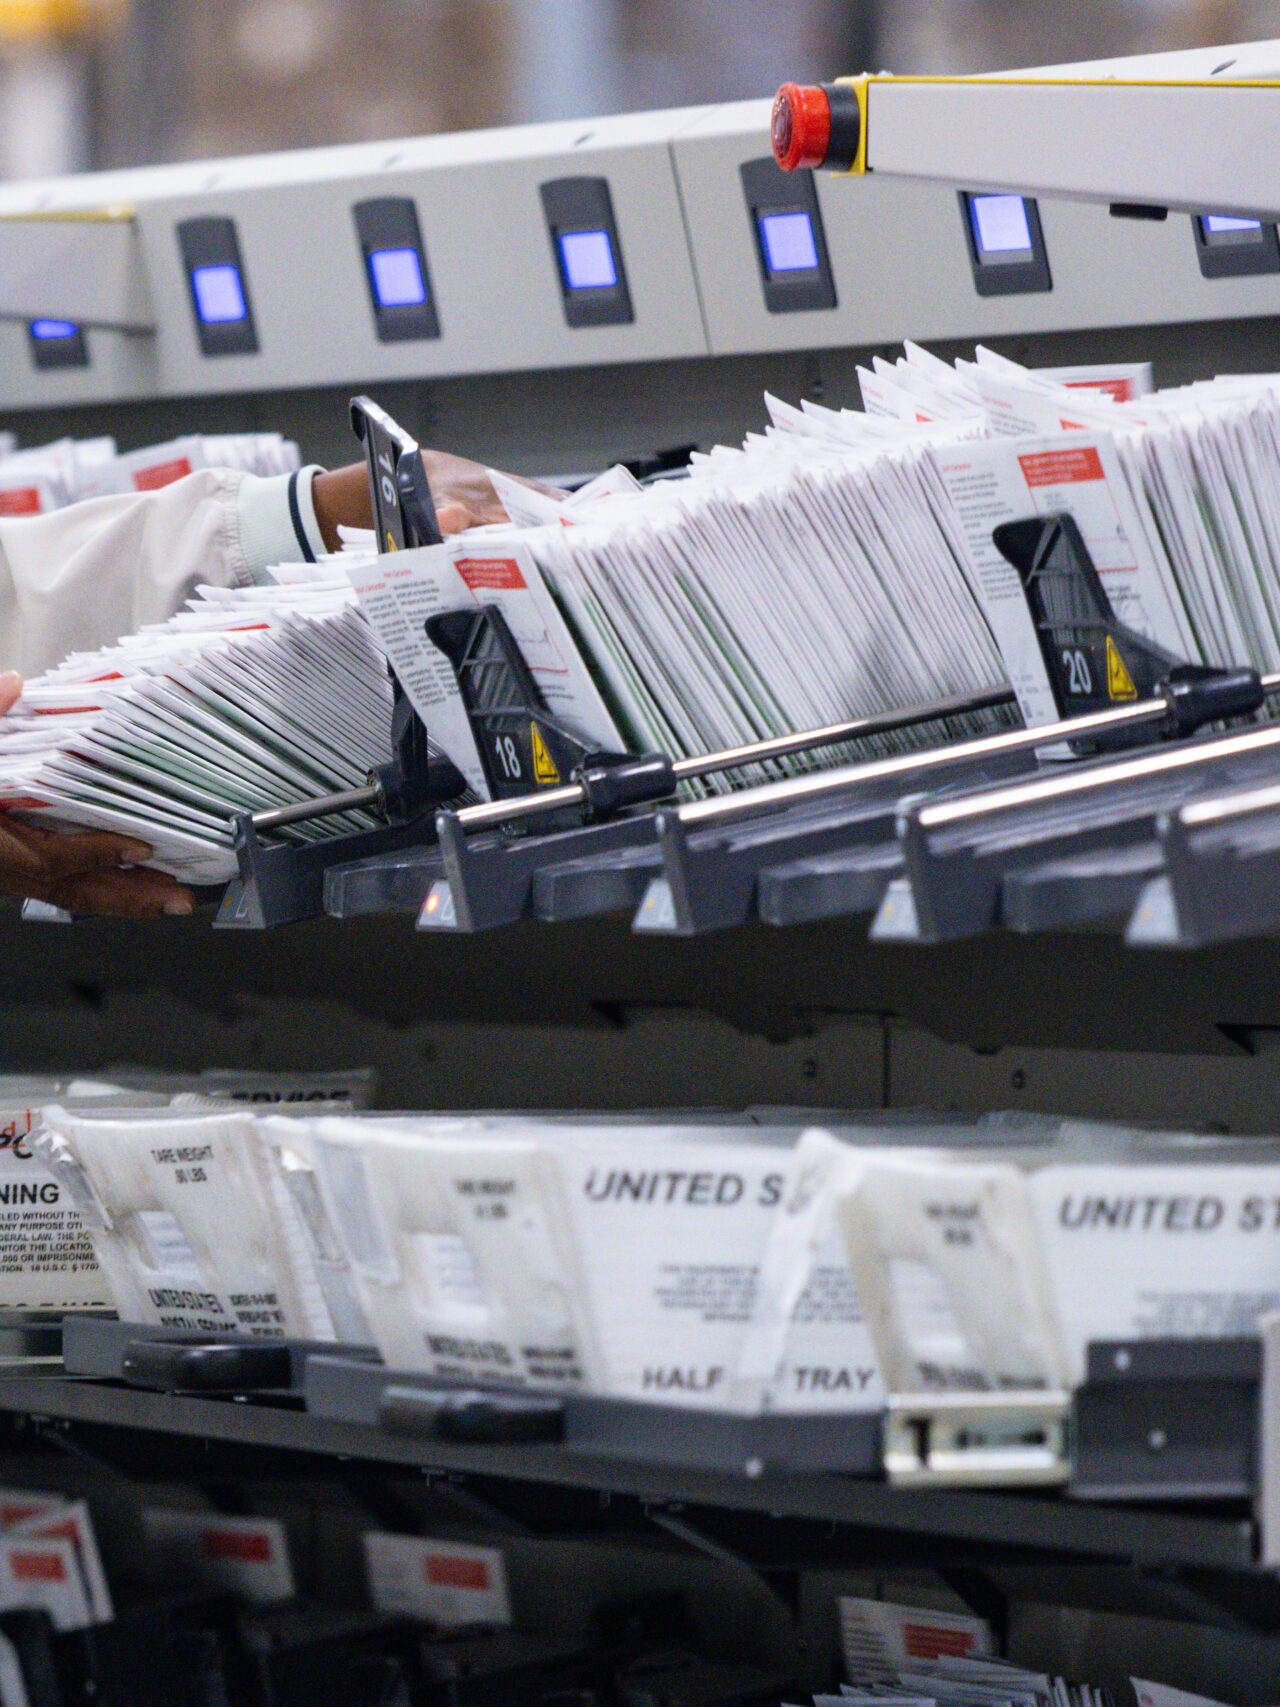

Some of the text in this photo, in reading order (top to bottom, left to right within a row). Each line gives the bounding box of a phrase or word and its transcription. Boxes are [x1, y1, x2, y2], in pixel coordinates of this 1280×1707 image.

[1062, 650, 1092, 694] 20
[495, 735, 521, 779] 18
[585, 1170, 745, 1206] UNITED
[22, 1211, 65, 1220] WITHOUT
[1060, 1195, 1224, 1231] UNITED
[20, 1222, 64, 1231] PURPOSE
[57, 1232, 74, 1240] THE
[30, 1243, 47, 1251] THE
[50, 1242, 93, 1251] LOCATIO
[21, 1253, 35, 1262] OR
[643, 1366, 875, 1392] HALF TRAY
